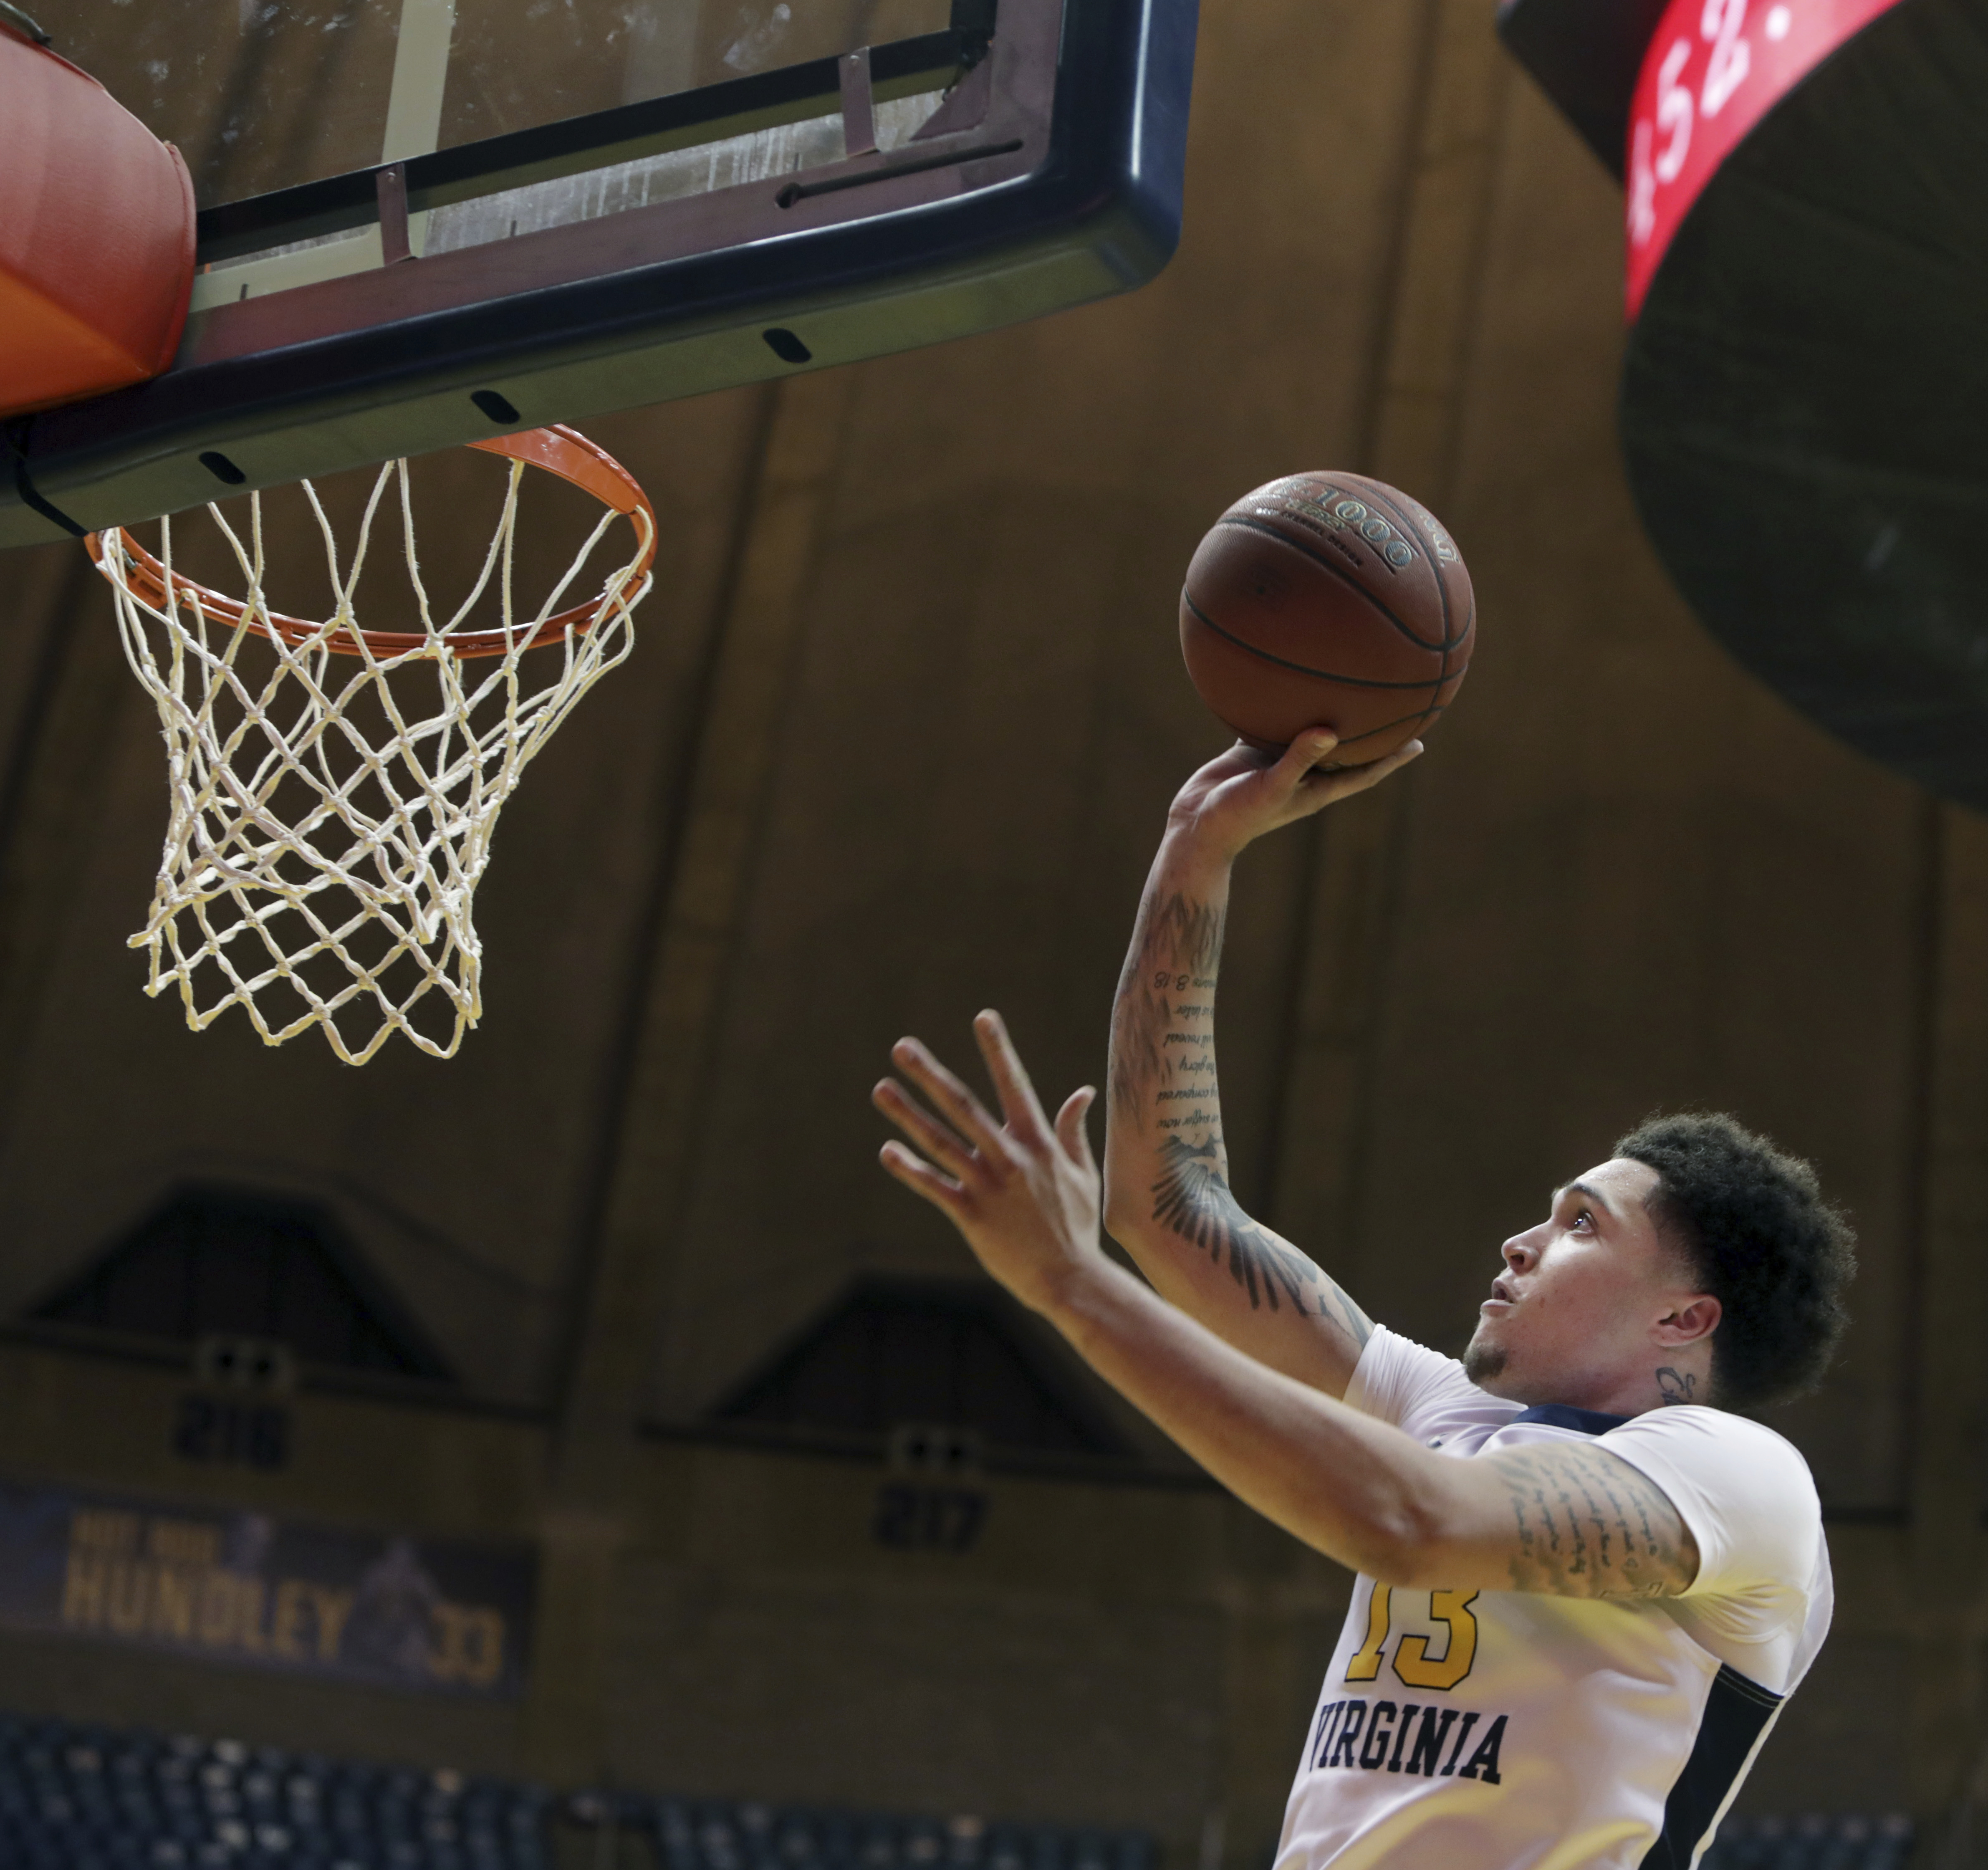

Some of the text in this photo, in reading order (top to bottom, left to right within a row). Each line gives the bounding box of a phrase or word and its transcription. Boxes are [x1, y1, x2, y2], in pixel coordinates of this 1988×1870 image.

[63, 1559, 355, 1661] HUNDLEY
[1344, 1581, 1480, 1691] 13
[1309, 1700, 1509, 1786] VIRGINIA
